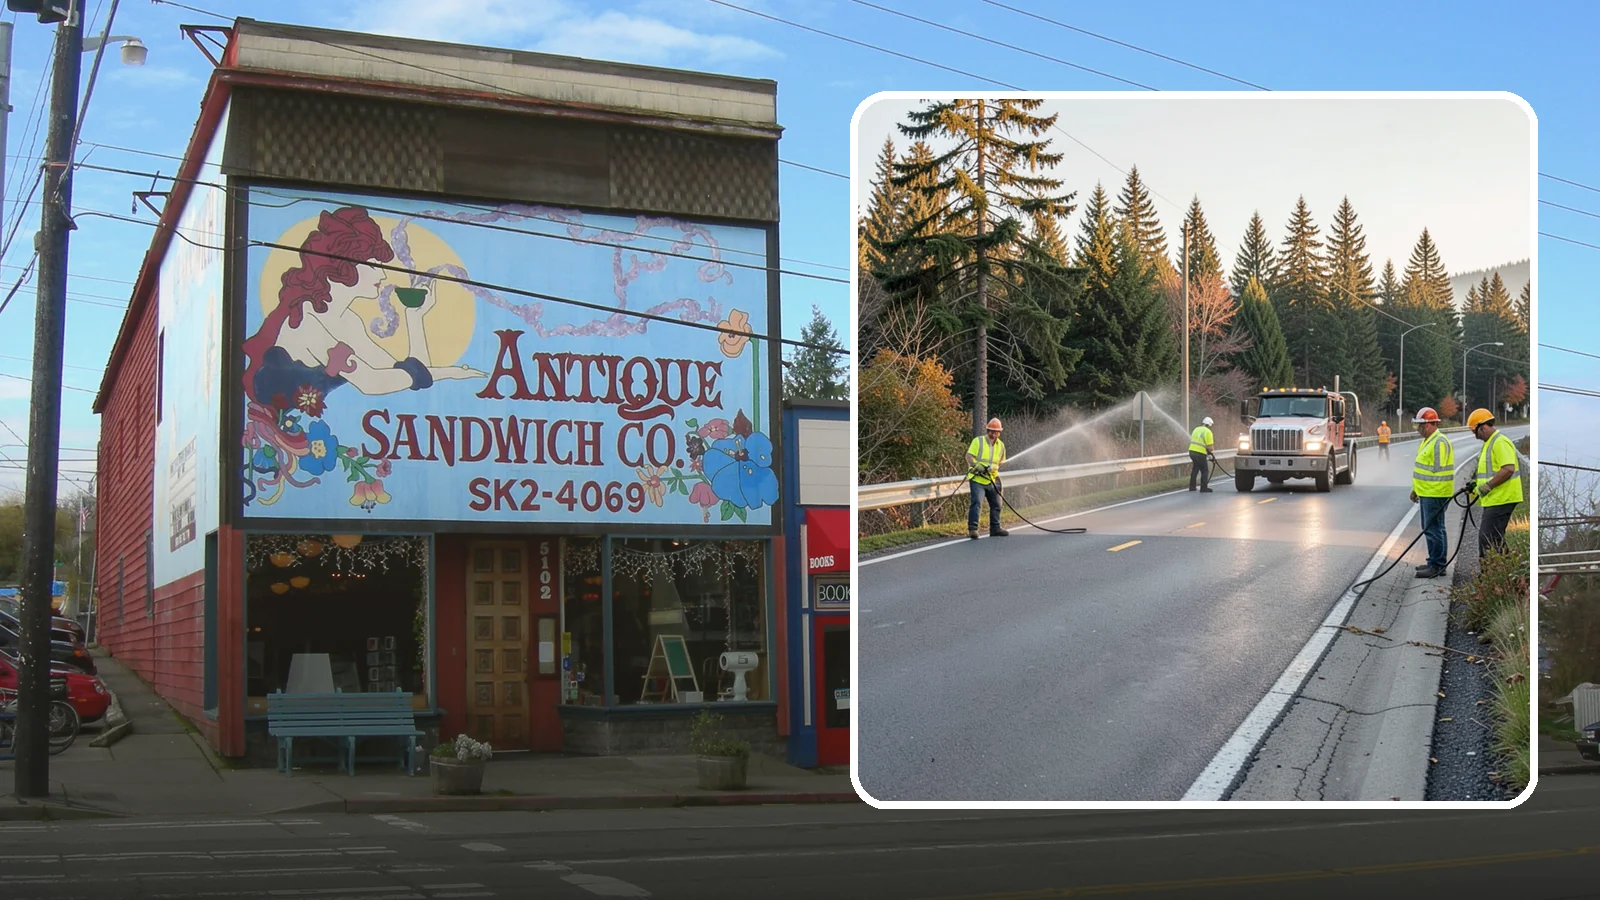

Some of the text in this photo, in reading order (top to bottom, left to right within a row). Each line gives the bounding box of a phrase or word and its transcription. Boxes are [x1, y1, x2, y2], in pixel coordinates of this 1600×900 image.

[476, 329, 723, 420] ANTIQUE
[361, 408, 685, 469] SANDWICH CO.
[469, 477, 646, 514] SK2-4069
[540, 541, 552, 600] 5102
[809, 555, 835, 569] BOOKS
